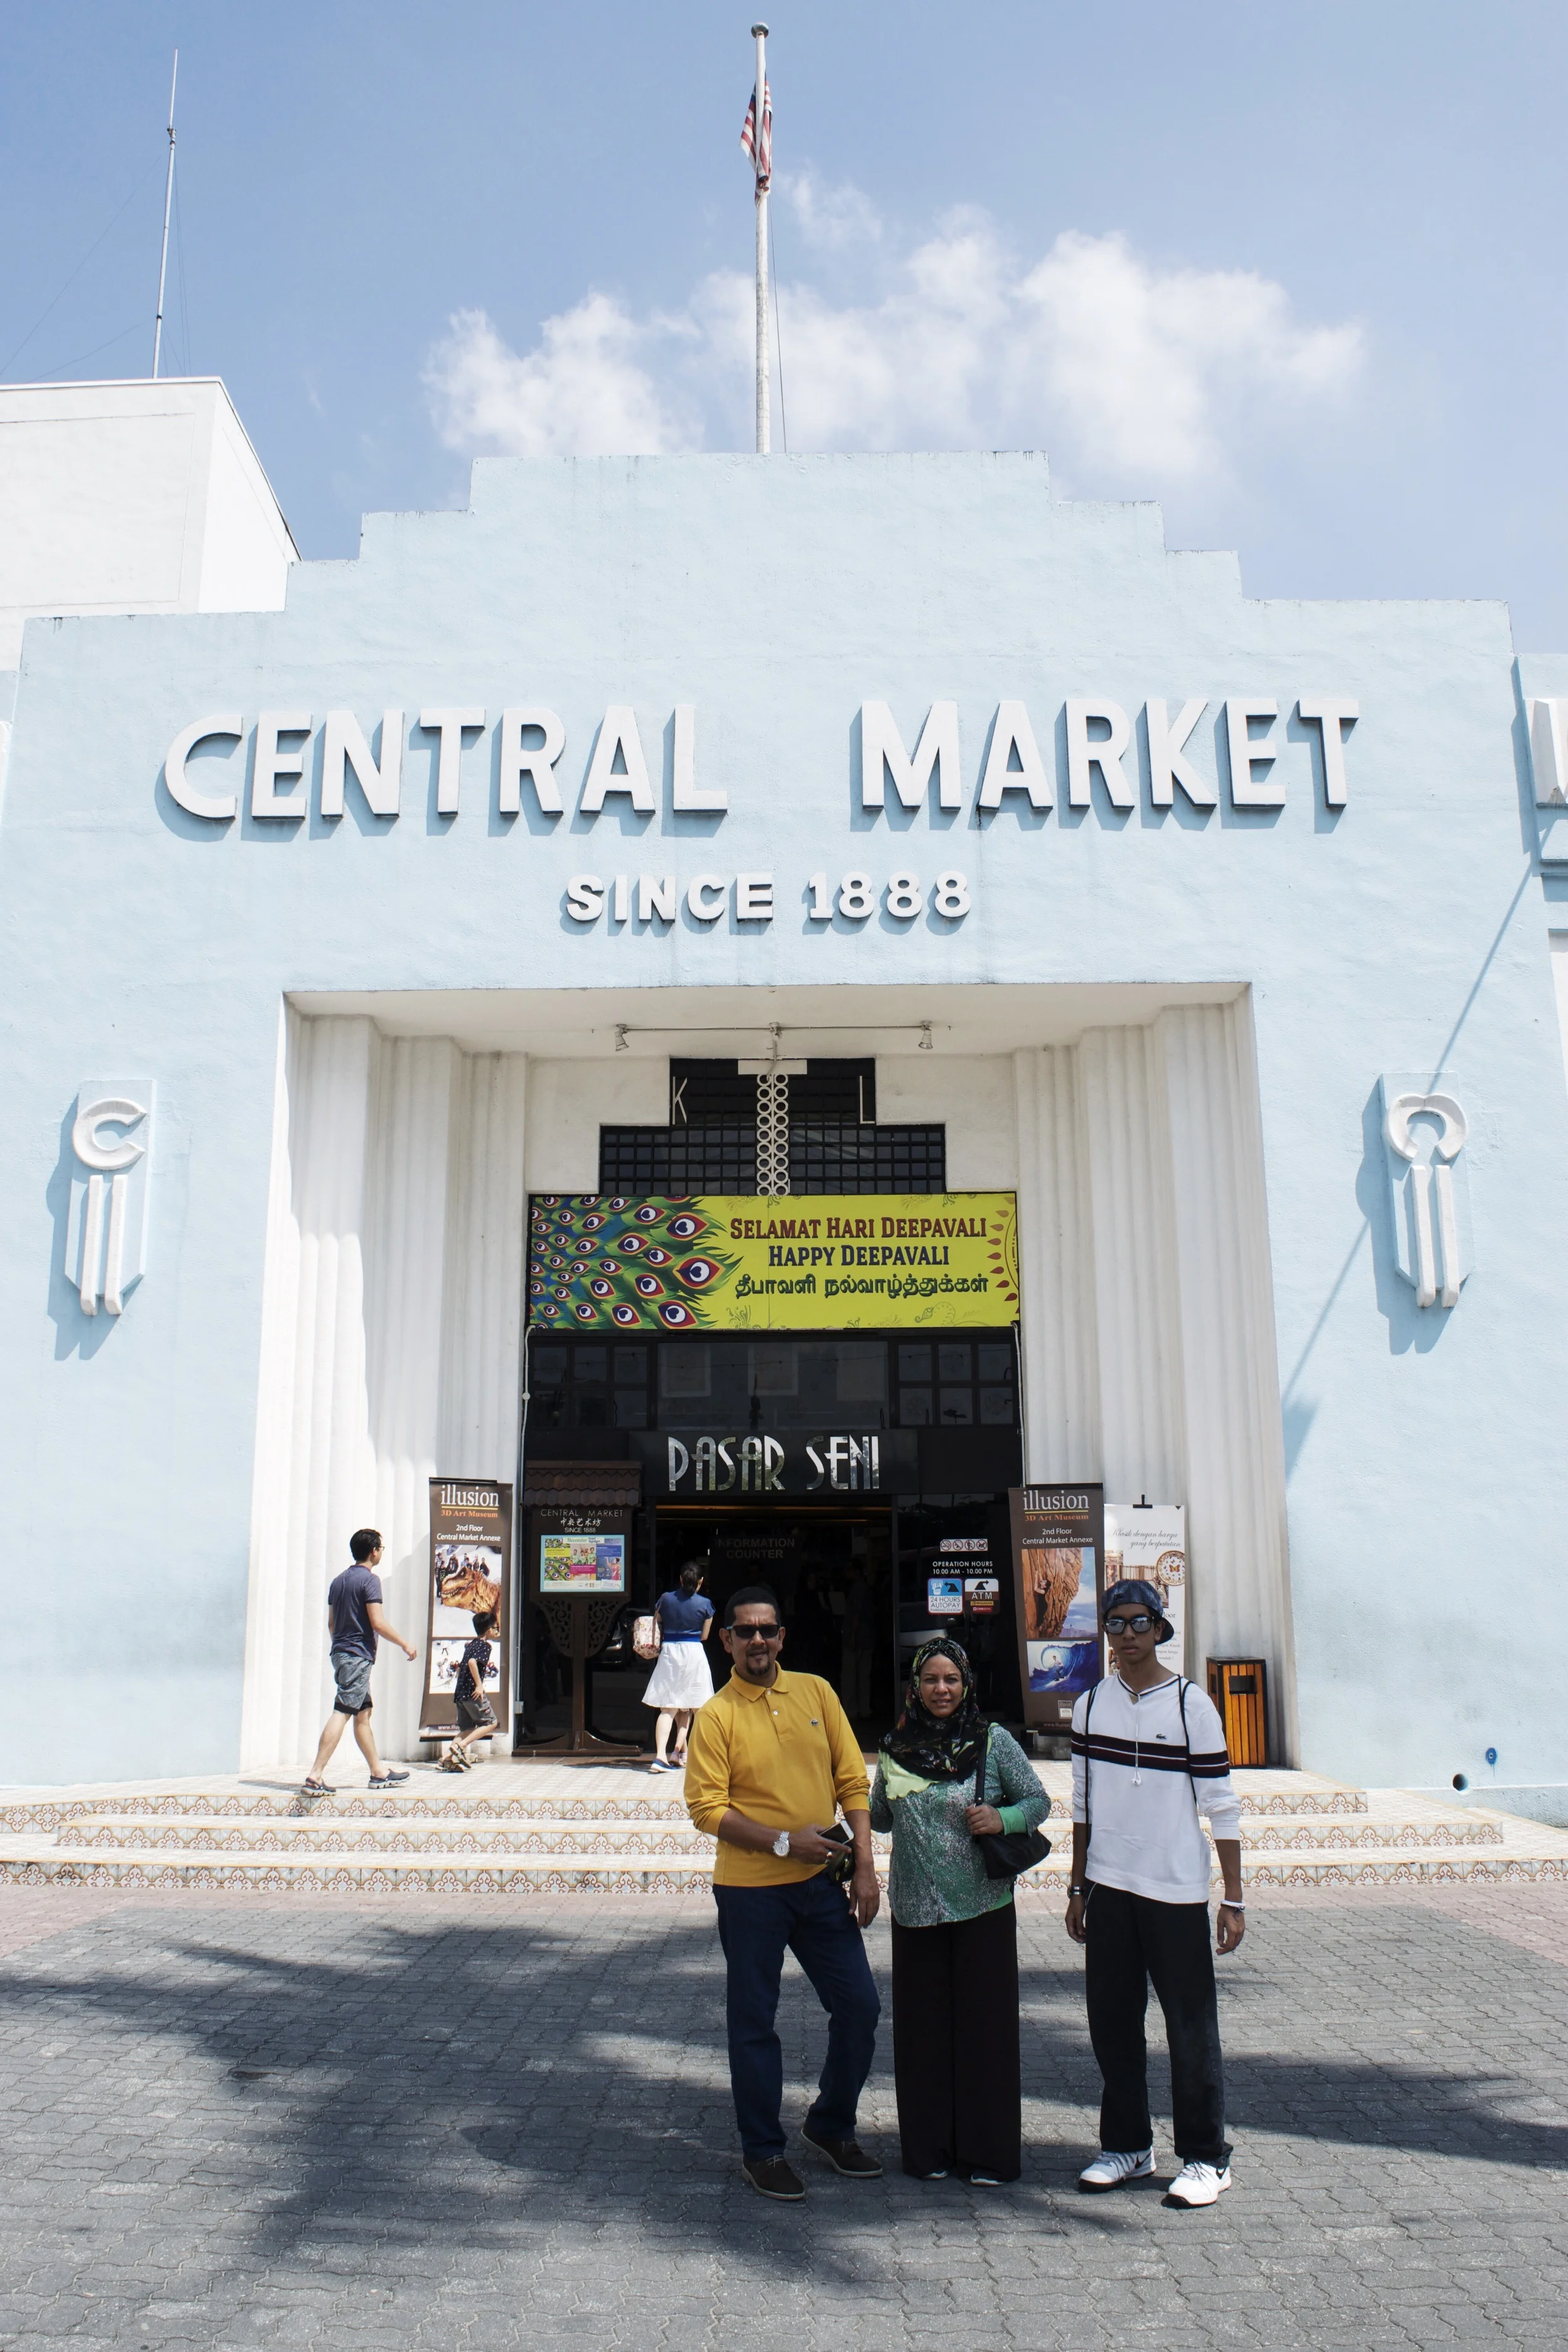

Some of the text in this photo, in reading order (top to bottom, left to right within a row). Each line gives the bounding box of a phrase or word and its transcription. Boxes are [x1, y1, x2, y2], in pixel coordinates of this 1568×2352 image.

[164, 697, 1359, 821] CENTRAL MARKET
[566, 869, 972, 923] SINCE 1888
[730, 1216, 987, 1240] SELAMAT HARI DEEPAVALI
[769, 1244, 950, 1267] HAPPY DEEPAVALI
[734, 1273, 816, 1300] தீபாவளி
[667, 1434, 880, 1491] PASAR SENI
[440, 1484, 499, 1507] illusion
[1022, 1490, 1090, 1510] illusion
[716, 1538, 795, 1548] INFORMATION
[1129, 1539, 1181, 1550] yang berpatutan
[1133, 1530, 1157, 1540] dengan
[1158, 1530, 1178, 1541] harga
[726, 1549, 783, 1559] COUNTER
[972, 1592, 992, 1600] ATM
